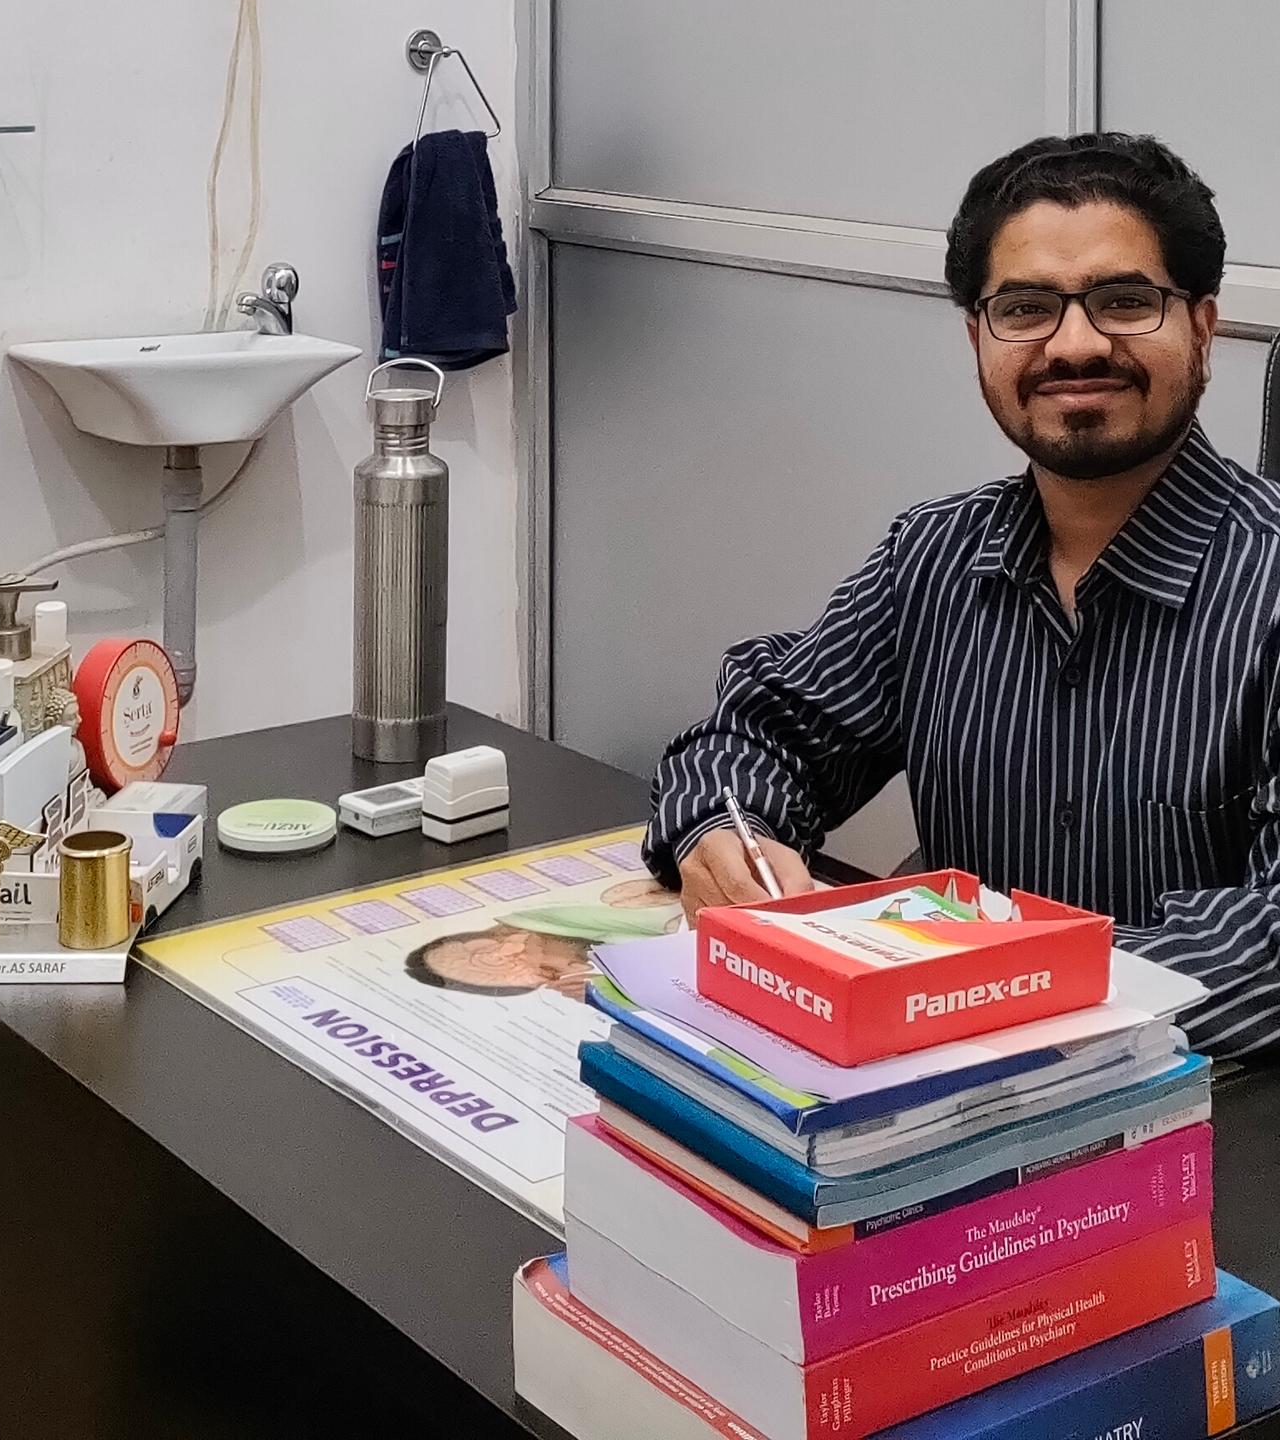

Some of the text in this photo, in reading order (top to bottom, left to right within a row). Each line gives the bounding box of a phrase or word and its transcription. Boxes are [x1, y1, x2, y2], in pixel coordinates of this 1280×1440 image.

[28, 962, 67, 975] SARAF
[302, 1008, 520, 1133] DEPRESSION
[865, 1203, 925, 1232] Psychiatric Clinics
[965, 1226, 986, 1244] The
[869, 1200, 1132, 1306] Prescribing Guidelines in Psychiatry
[929, 1289, 1106, 1372] Practice Guidelines for Physical Health
[964, 1320, 1078, 1375] Conditions in Psychiatry
